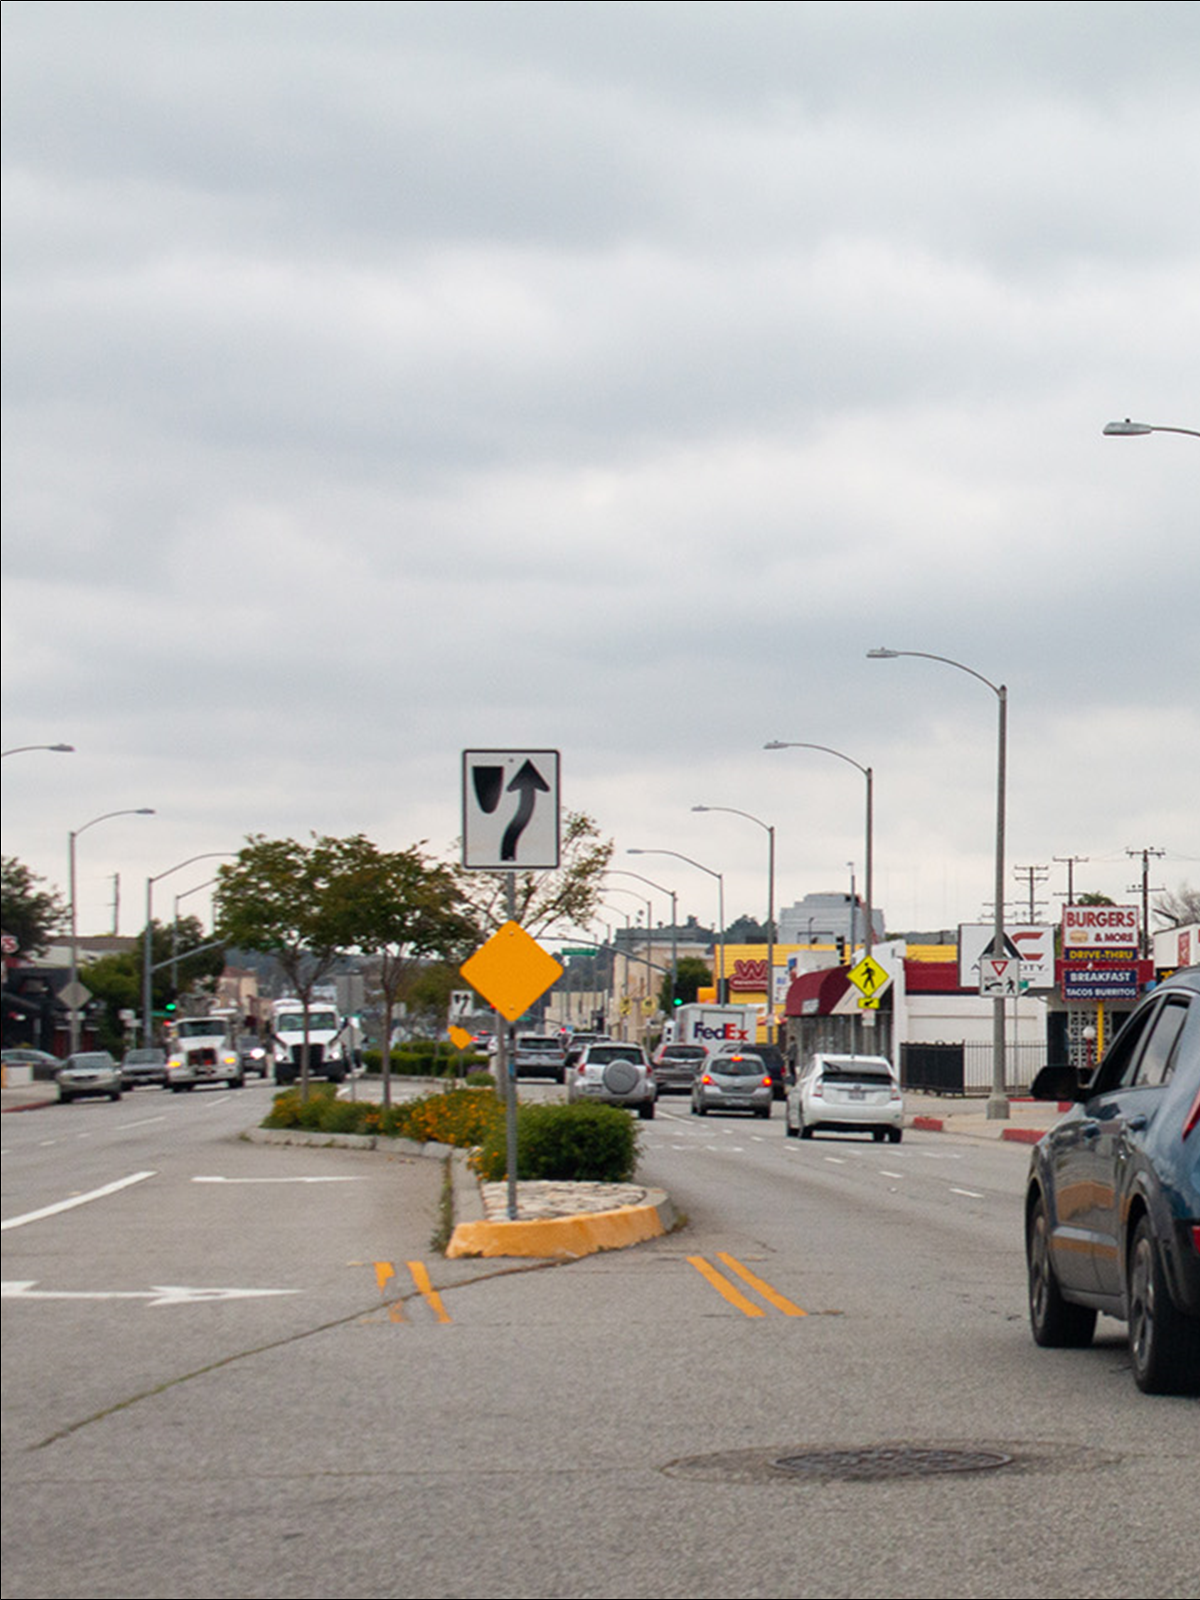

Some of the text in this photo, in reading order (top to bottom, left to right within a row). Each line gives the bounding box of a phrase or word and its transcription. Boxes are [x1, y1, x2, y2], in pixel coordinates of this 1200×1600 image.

[1066, 911, 1135, 928] BURGERS
[1094, 932, 1133, 943] & MORE
[1069, 951, 1133, 960] DRIVE-THRU
[1070, 971, 1131, 983] BREAKFAST
[1066, 987, 1136, 997] TACOS BURRITOS
[694, 1022, 749, 1041] FedEx
